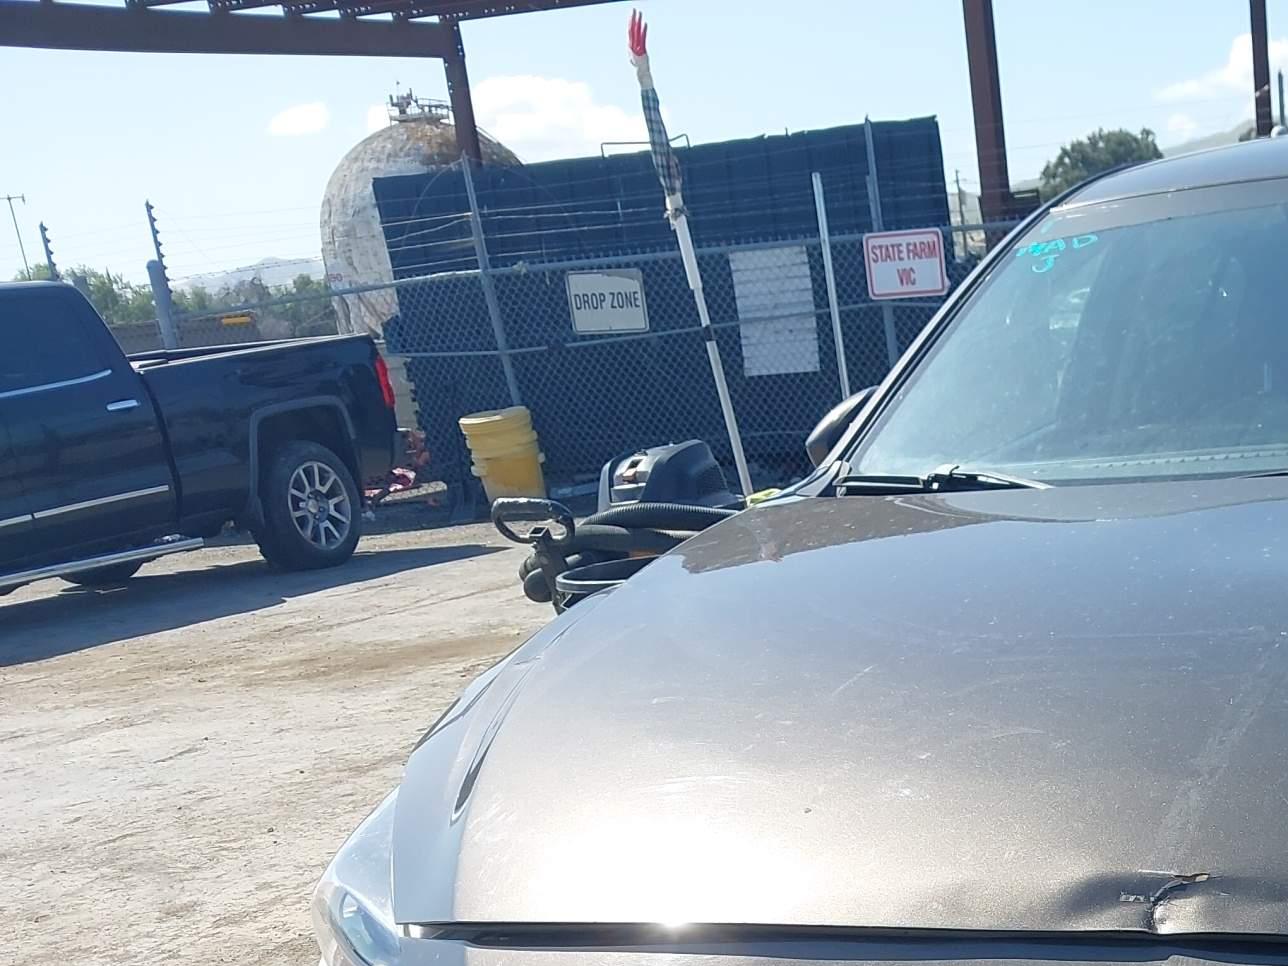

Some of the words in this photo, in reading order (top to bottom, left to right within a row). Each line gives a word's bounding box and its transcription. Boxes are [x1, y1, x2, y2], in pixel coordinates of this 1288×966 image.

[871, 243, 905, 263] STATE
[906, 240, 938, 260] FARM
[896, 266, 917, 287] VIC
[574, 292, 606, 310] DROP
[609, 290, 641, 309] ZONE
